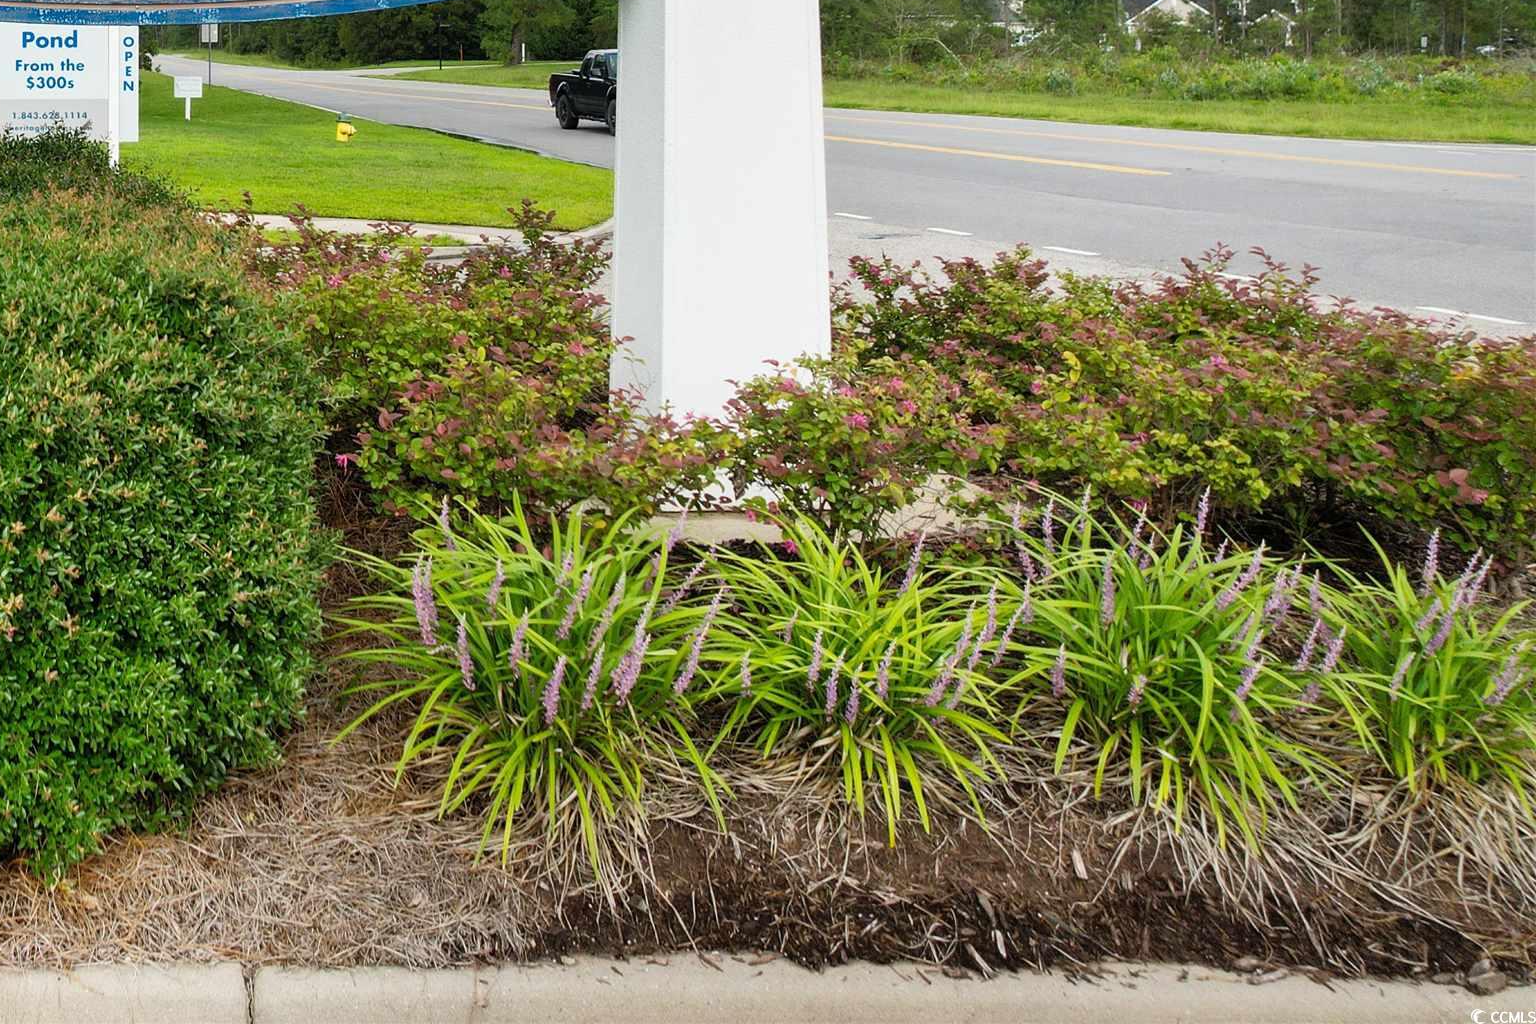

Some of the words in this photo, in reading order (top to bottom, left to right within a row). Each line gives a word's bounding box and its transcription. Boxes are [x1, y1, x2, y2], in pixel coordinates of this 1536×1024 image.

[22, 30, 78, 49] Pond
[15, 59, 54, 72] From
[60, 58, 85, 72] the
[122, 36, 135, 92] OPEN
[26, 76, 75, 90] $300s
[12, 111, 88, 120] 1.843.628.1114
